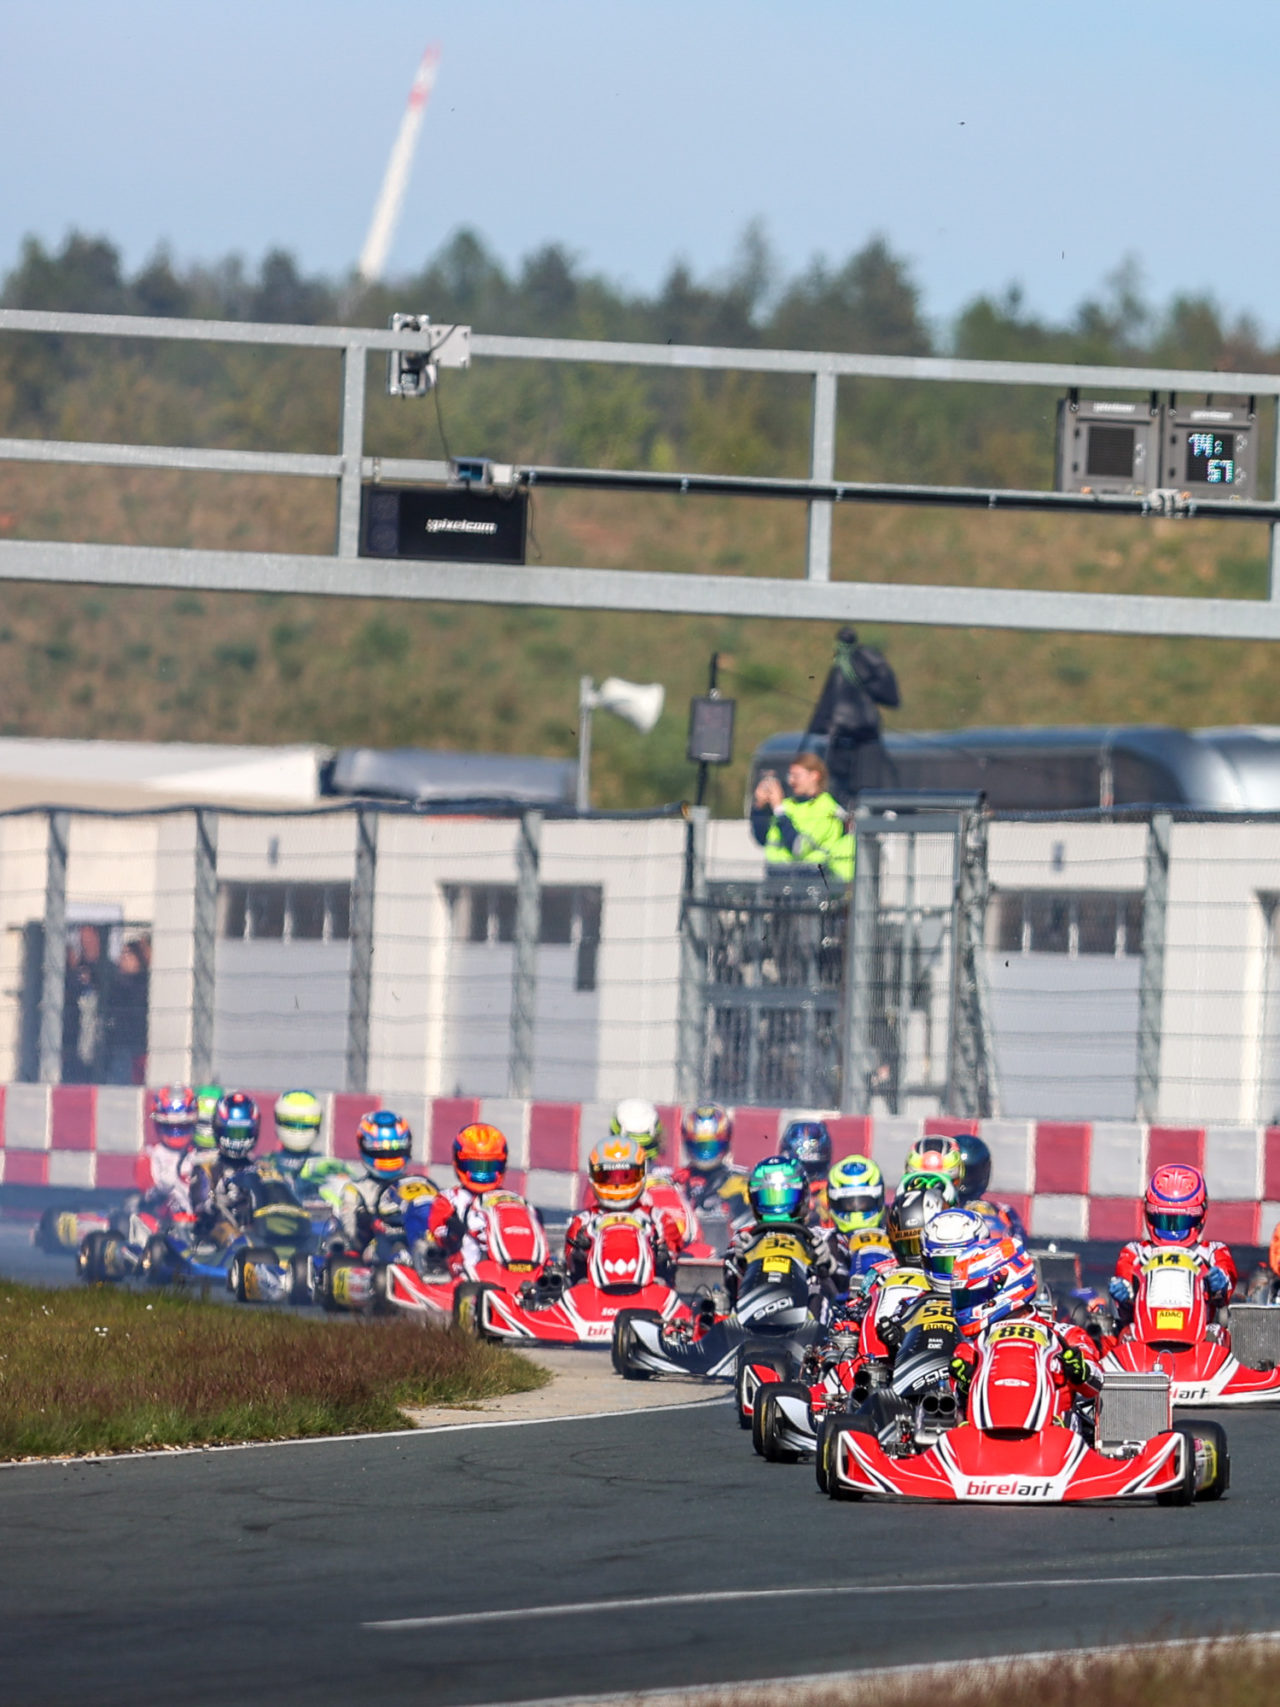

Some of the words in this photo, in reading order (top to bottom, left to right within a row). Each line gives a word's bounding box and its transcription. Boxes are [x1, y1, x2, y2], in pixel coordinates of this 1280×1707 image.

[1208, 460, 1234, 483] 57
[1152, 1254, 1180, 1265] 14
[899, 1275, 915, 1285] 7
[923, 1306, 953, 1317] 58
[1160, 1310, 1181, 1318] ADAC
[999, 1326, 1036, 1338] 88
[966, 1481, 1054, 1497] birelart
